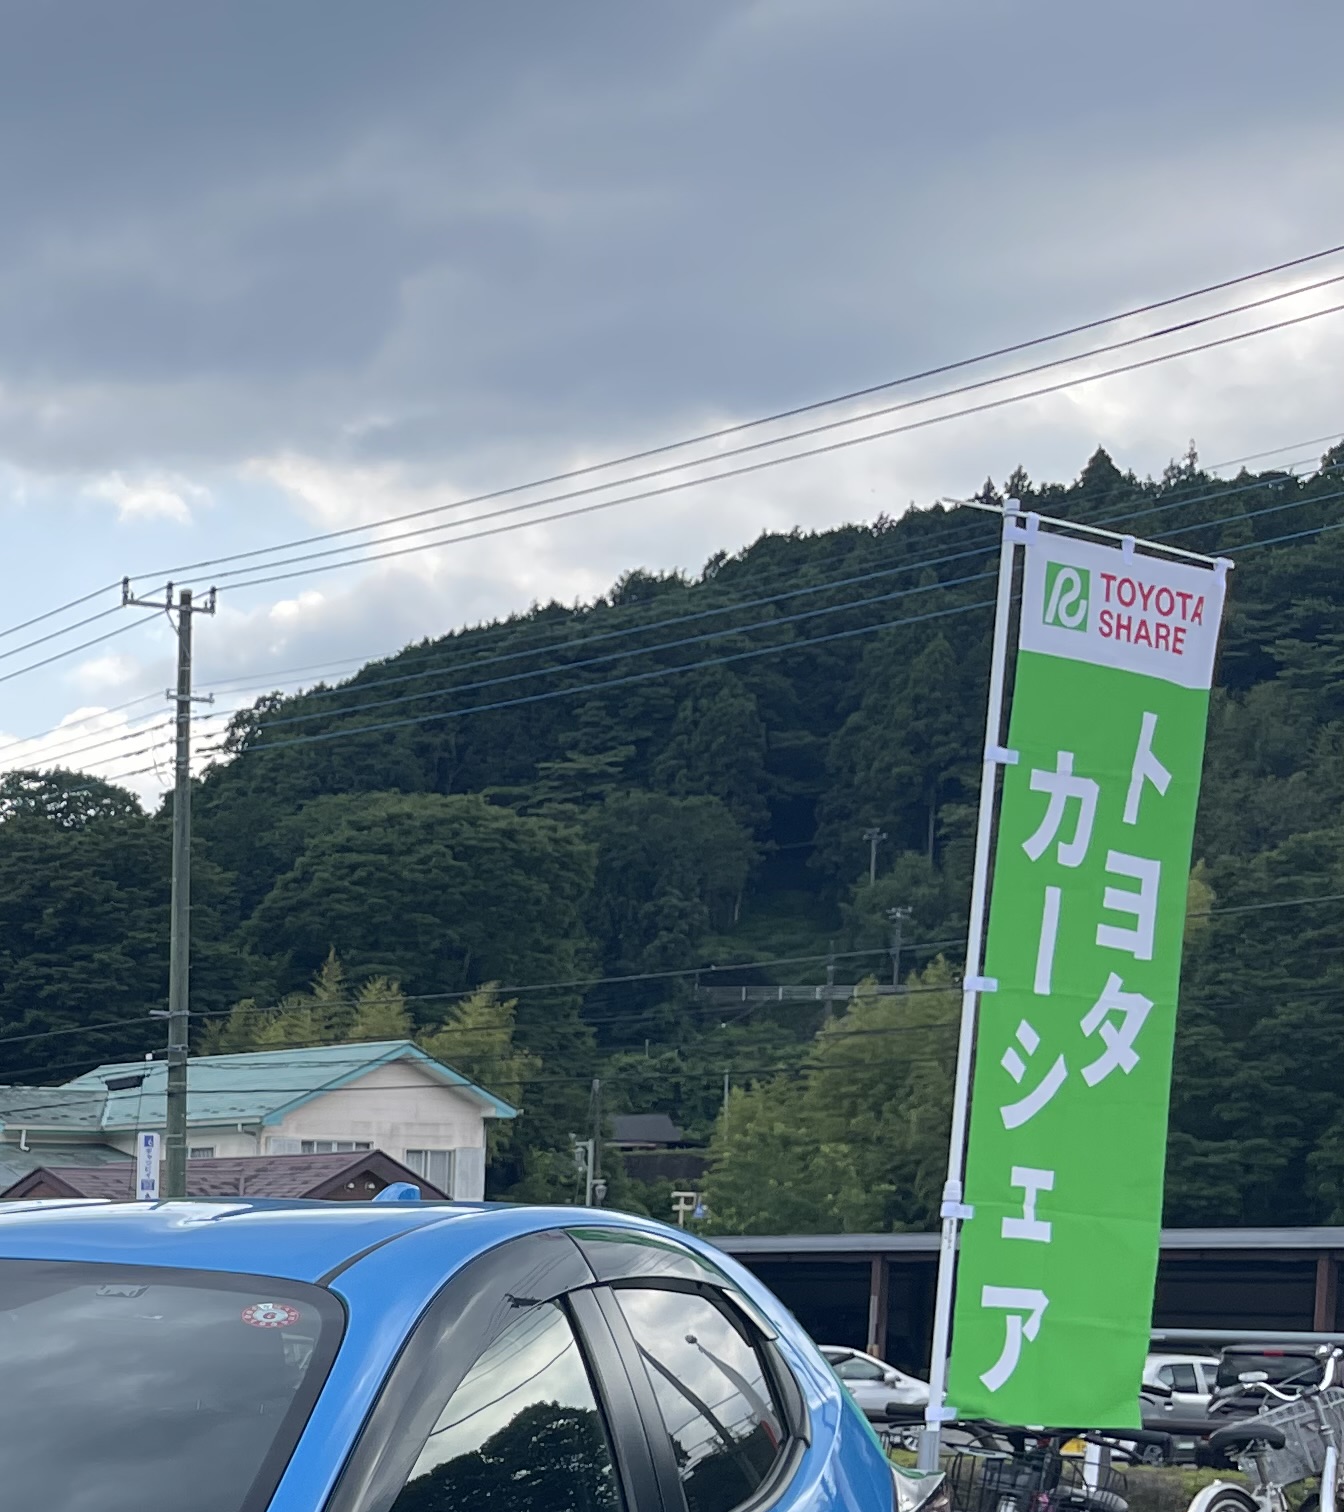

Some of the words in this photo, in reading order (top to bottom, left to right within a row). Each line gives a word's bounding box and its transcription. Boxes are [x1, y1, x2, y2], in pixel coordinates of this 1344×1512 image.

[1100, 573, 1206, 622] TOYOTA
[1099, 608, 1187, 656] SHARE
[1079, 711, 1173, 1088] トヨタ
